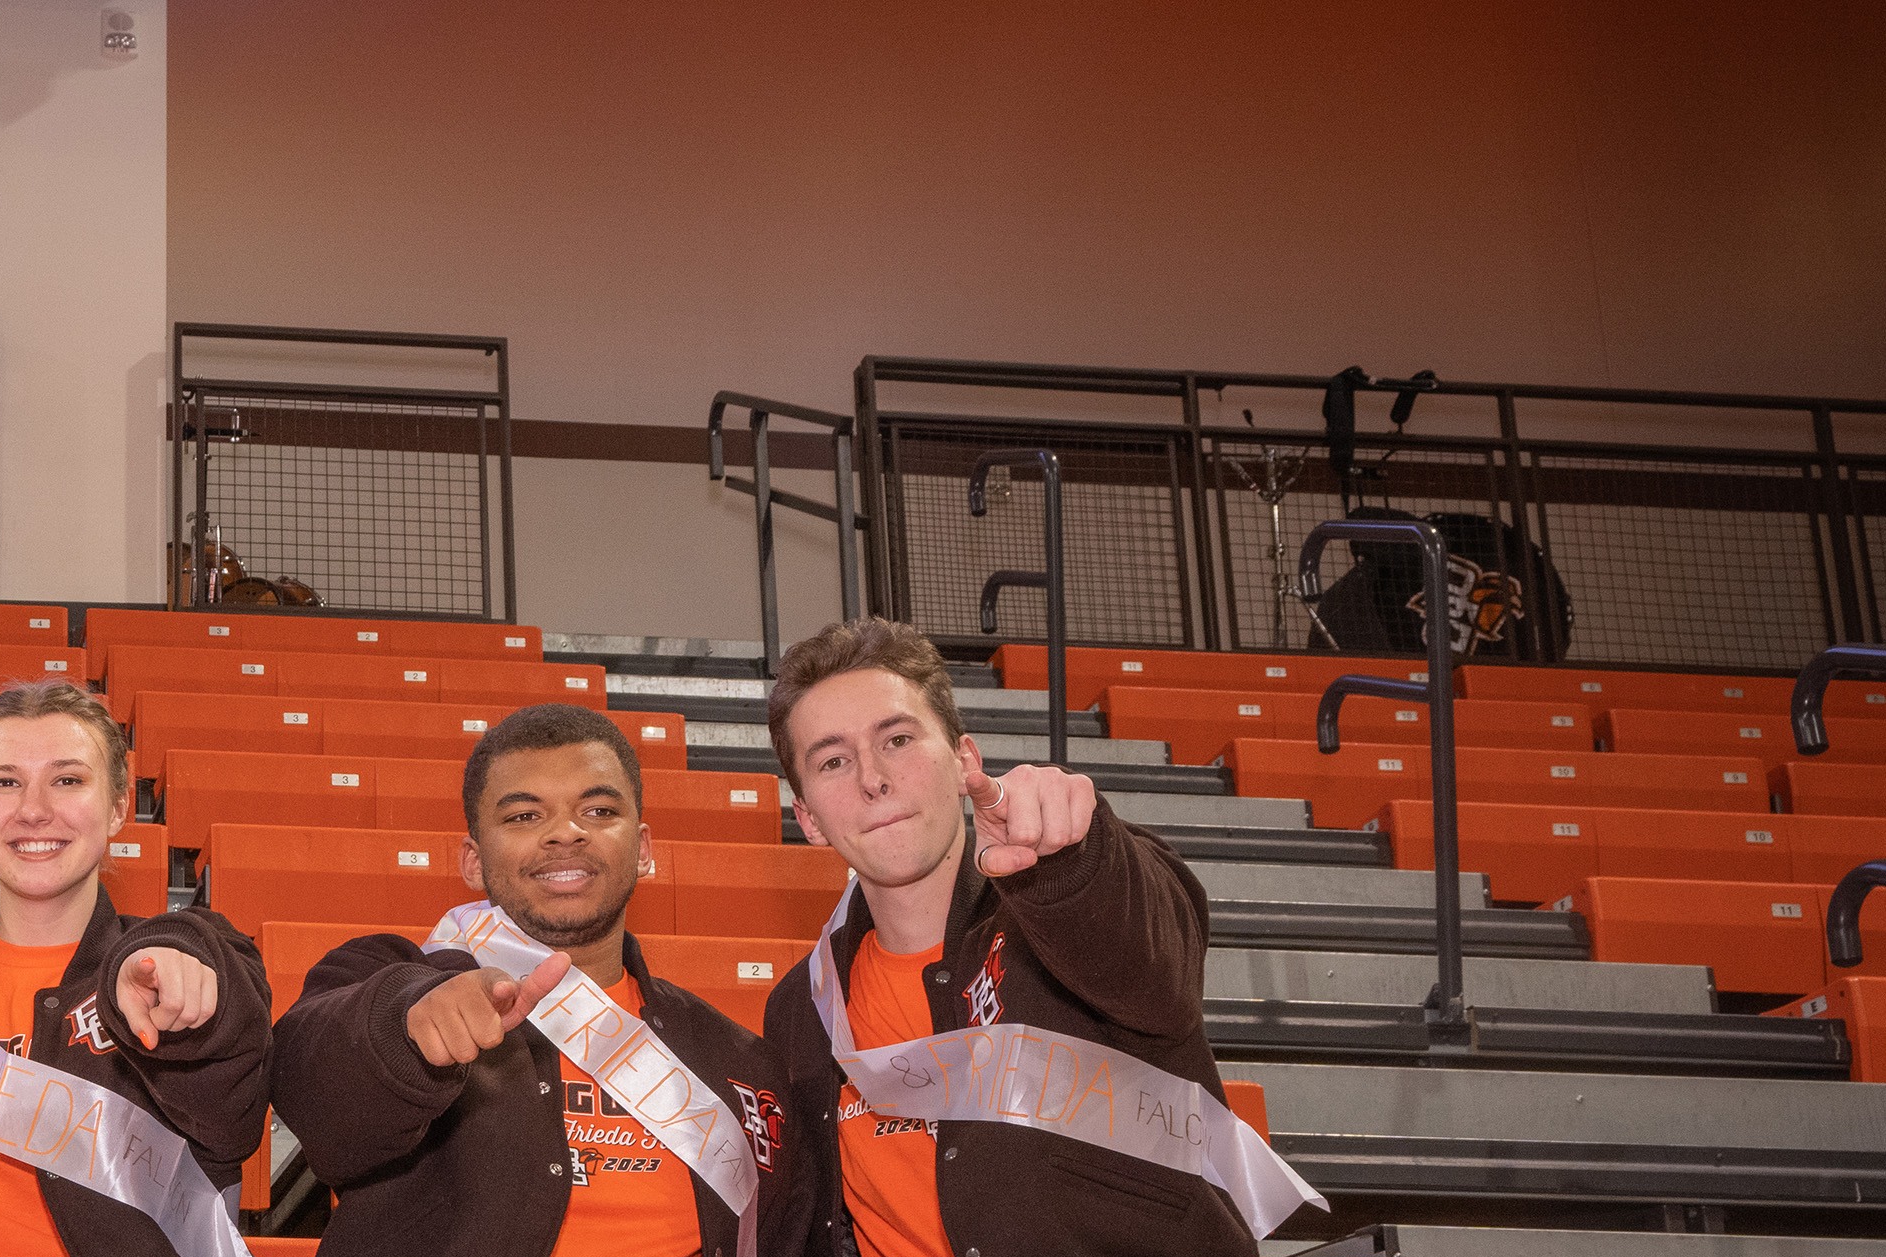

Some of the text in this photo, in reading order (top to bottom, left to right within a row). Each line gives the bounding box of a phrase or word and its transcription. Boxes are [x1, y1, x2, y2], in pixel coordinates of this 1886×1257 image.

[216, 627, 222, 635] 3
[365, 633, 371, 641] 2
[513, 638, 517, 646] 1
[250, 665, 256, 674] 3
[412, 672, 419, 680] 2
[292, 714, 299, 723] 3
[342, 775, 349, 785] 3
[741, 792, 746, 801] 1
[1560, 826, 1571, 834] 11
[121, 845, 129, 855] 4
[410, 853, 418, 864] 3
[1780, 906, 1793, 915] 11
[751, 964, 760, 976] 2
[539, 982, 718, 1161] FRIEDA
[890, 1055, 936, 1089] &
[927, 1032, 1114, 1137] FRIEDA
[601, 1157, 663, 1172] 2023
